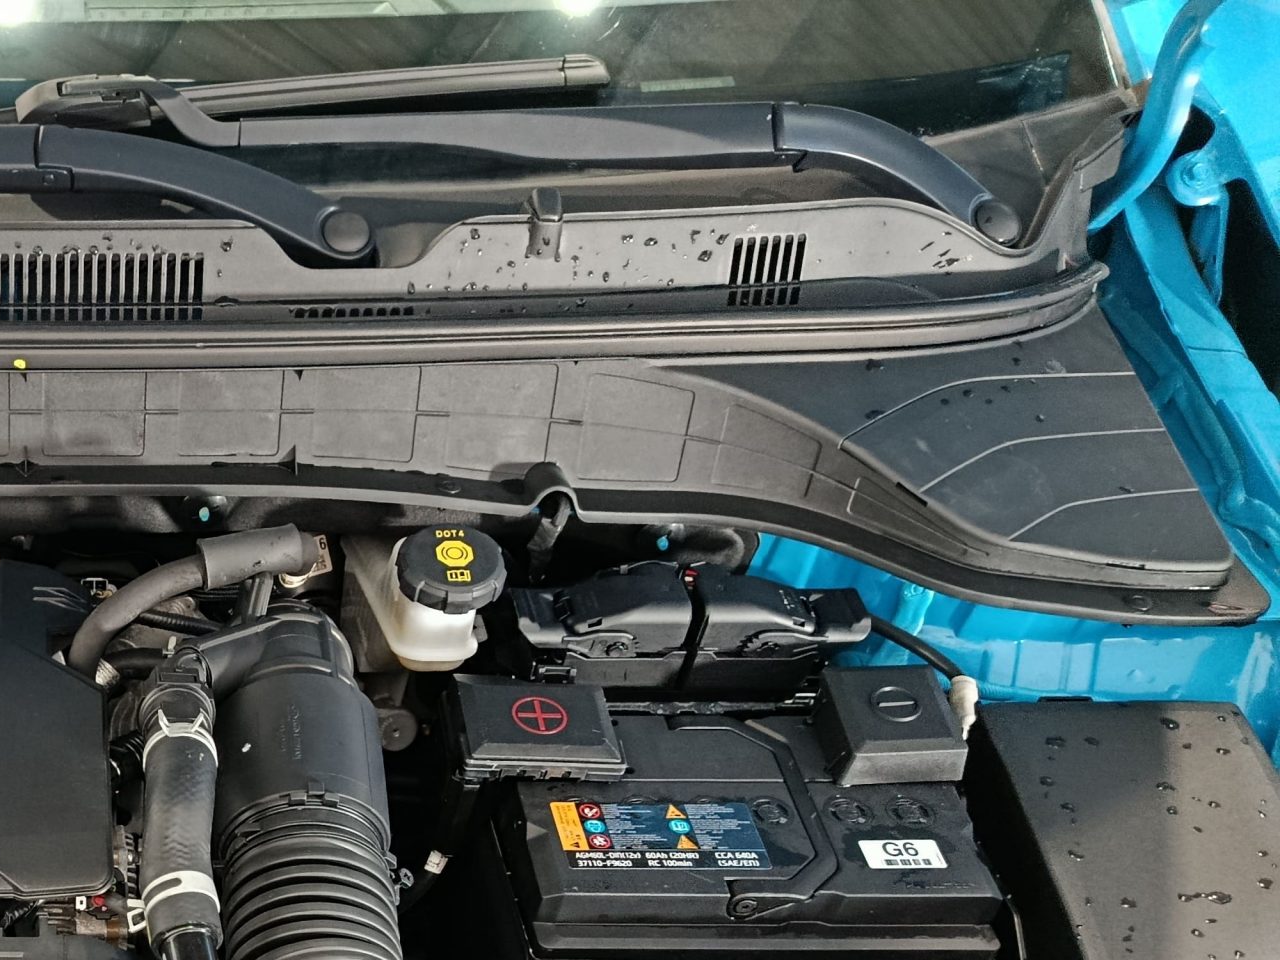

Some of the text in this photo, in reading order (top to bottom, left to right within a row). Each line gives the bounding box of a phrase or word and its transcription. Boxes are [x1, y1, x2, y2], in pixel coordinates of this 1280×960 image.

[435, 529, 465, 538] DOT 4
[319, 537, 327, 550] 6
[881, 842, 919, 856] G6
